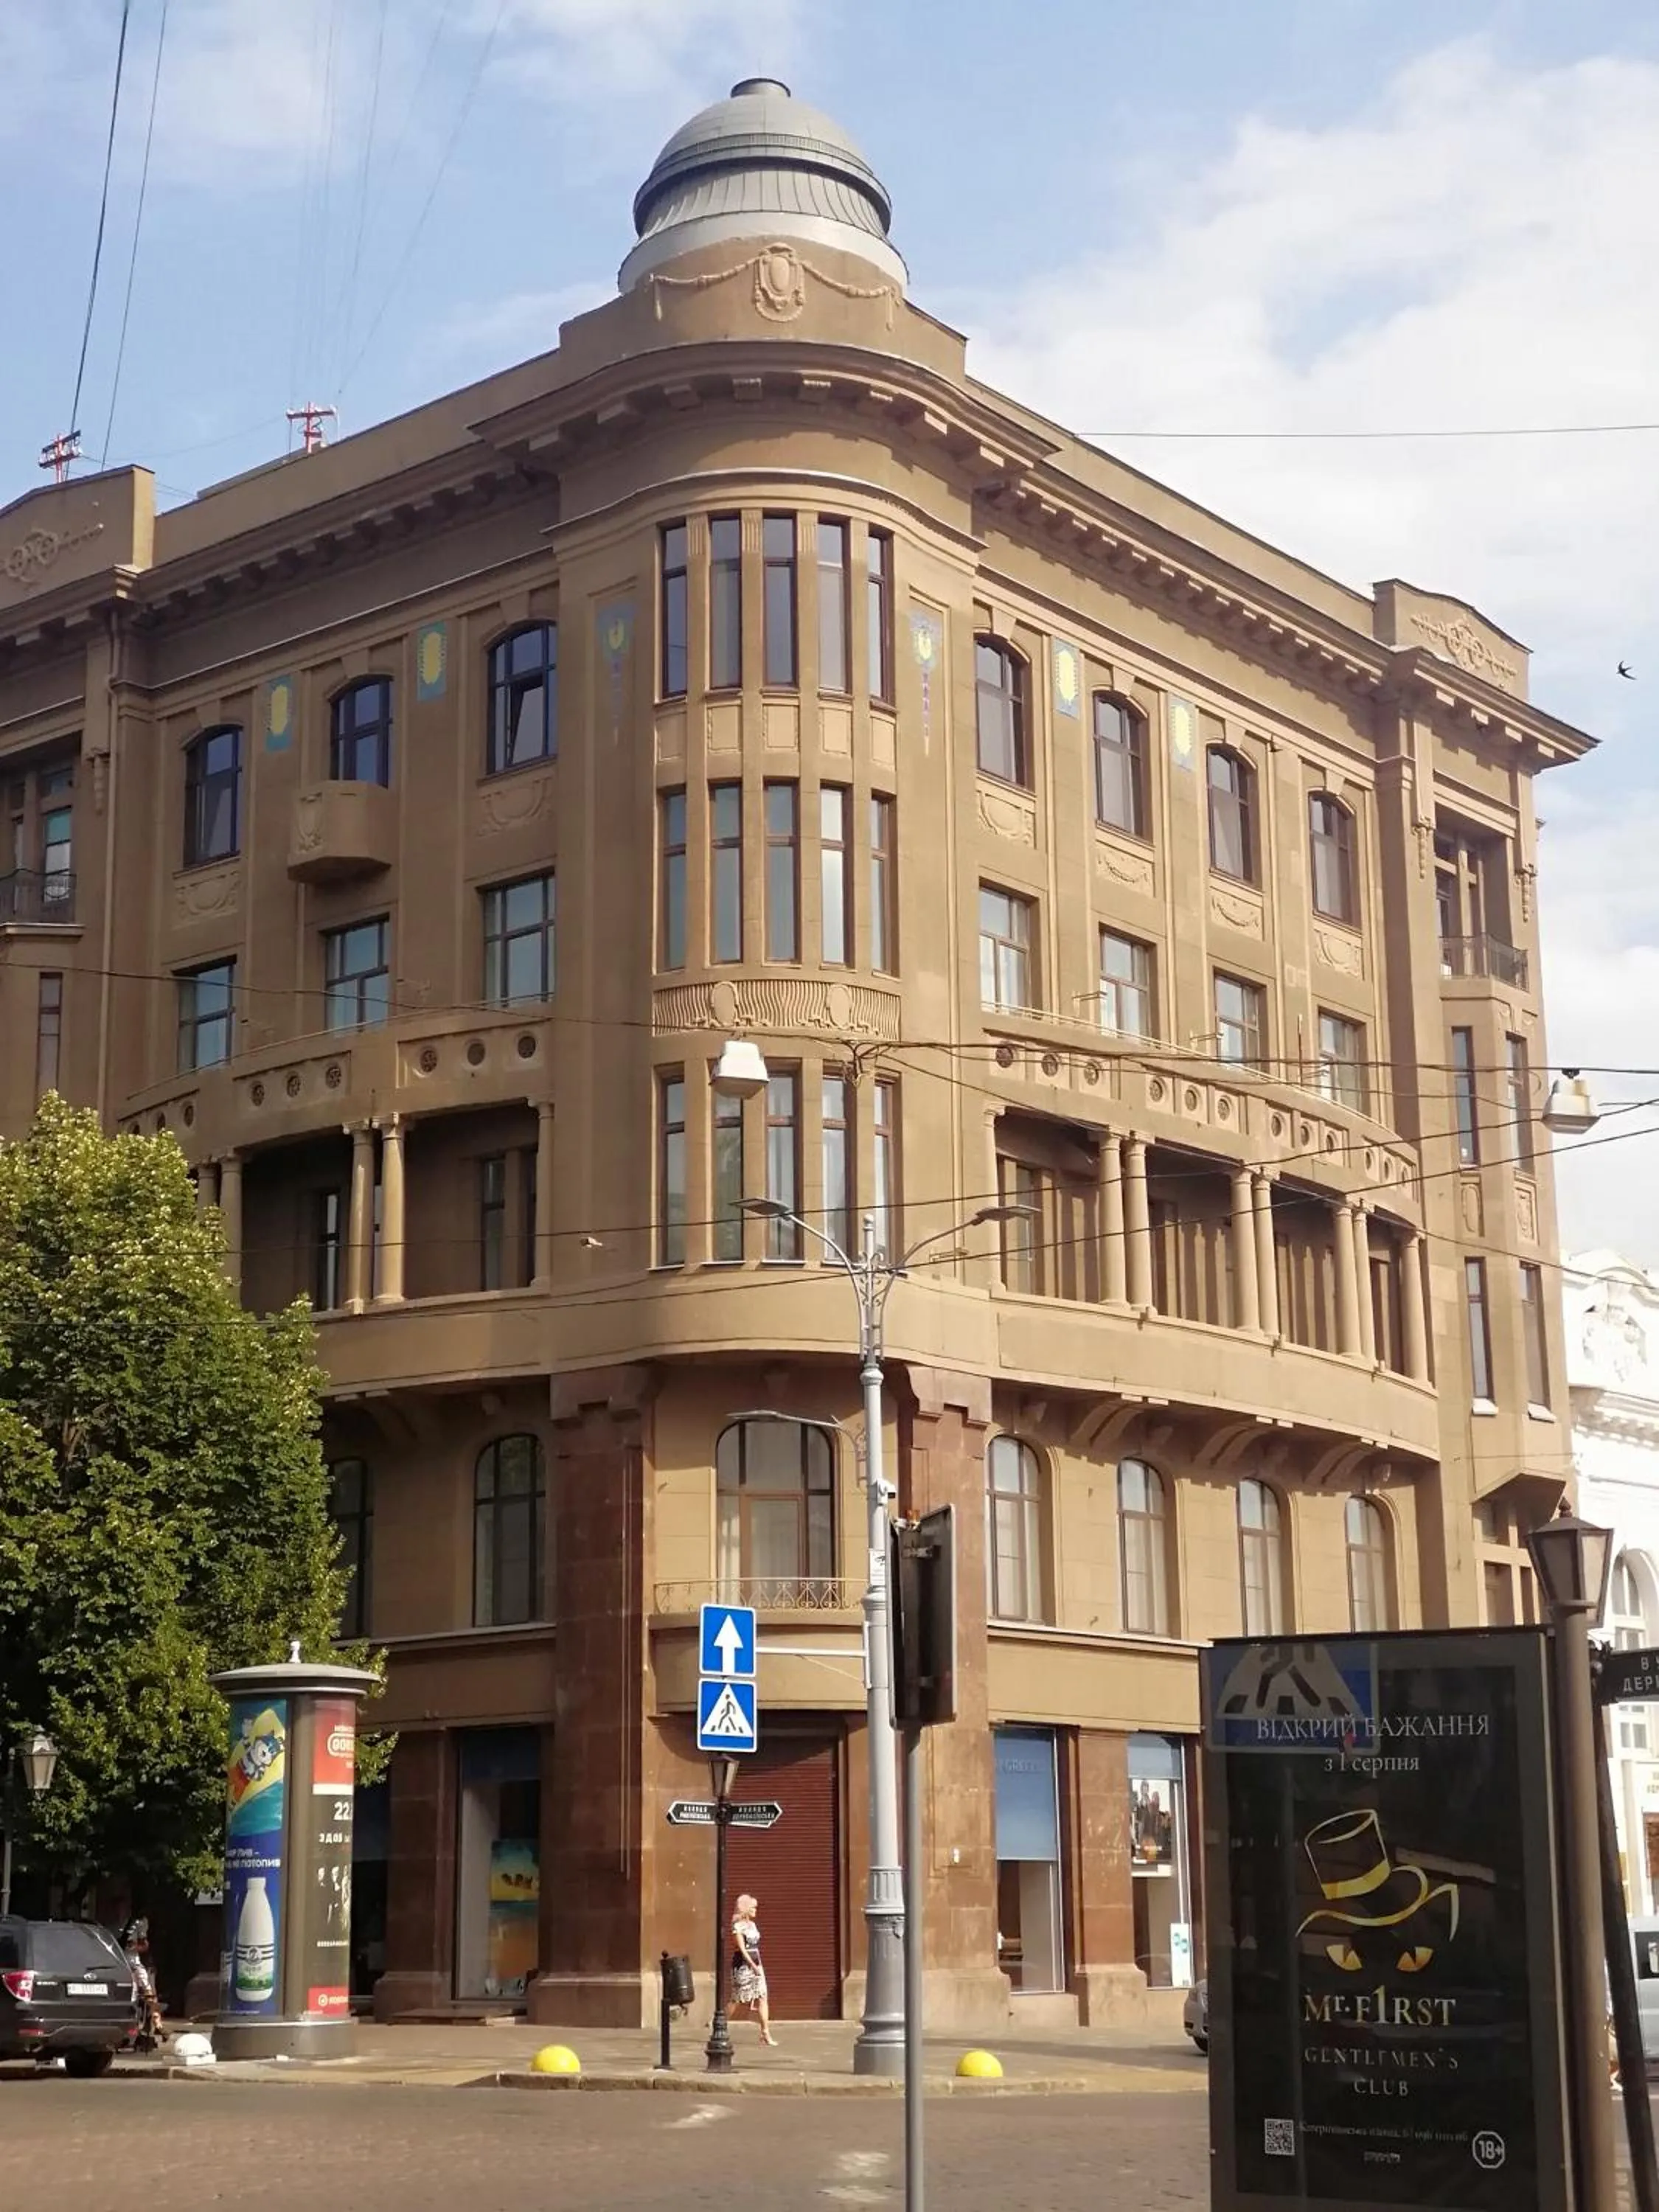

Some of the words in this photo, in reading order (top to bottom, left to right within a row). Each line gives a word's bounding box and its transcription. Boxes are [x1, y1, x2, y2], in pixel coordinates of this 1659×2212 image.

[1256, 1713, 1357, 1741] ВІДКРИЙ
[1365, 1714, 1489, 1737] БАЖАННЯ
[1352, 1756, 1420, 1778] серпня
[1354, 2078, 1409, 2096] CLUB
[1478, 2140, 1504, 2160] 18+
